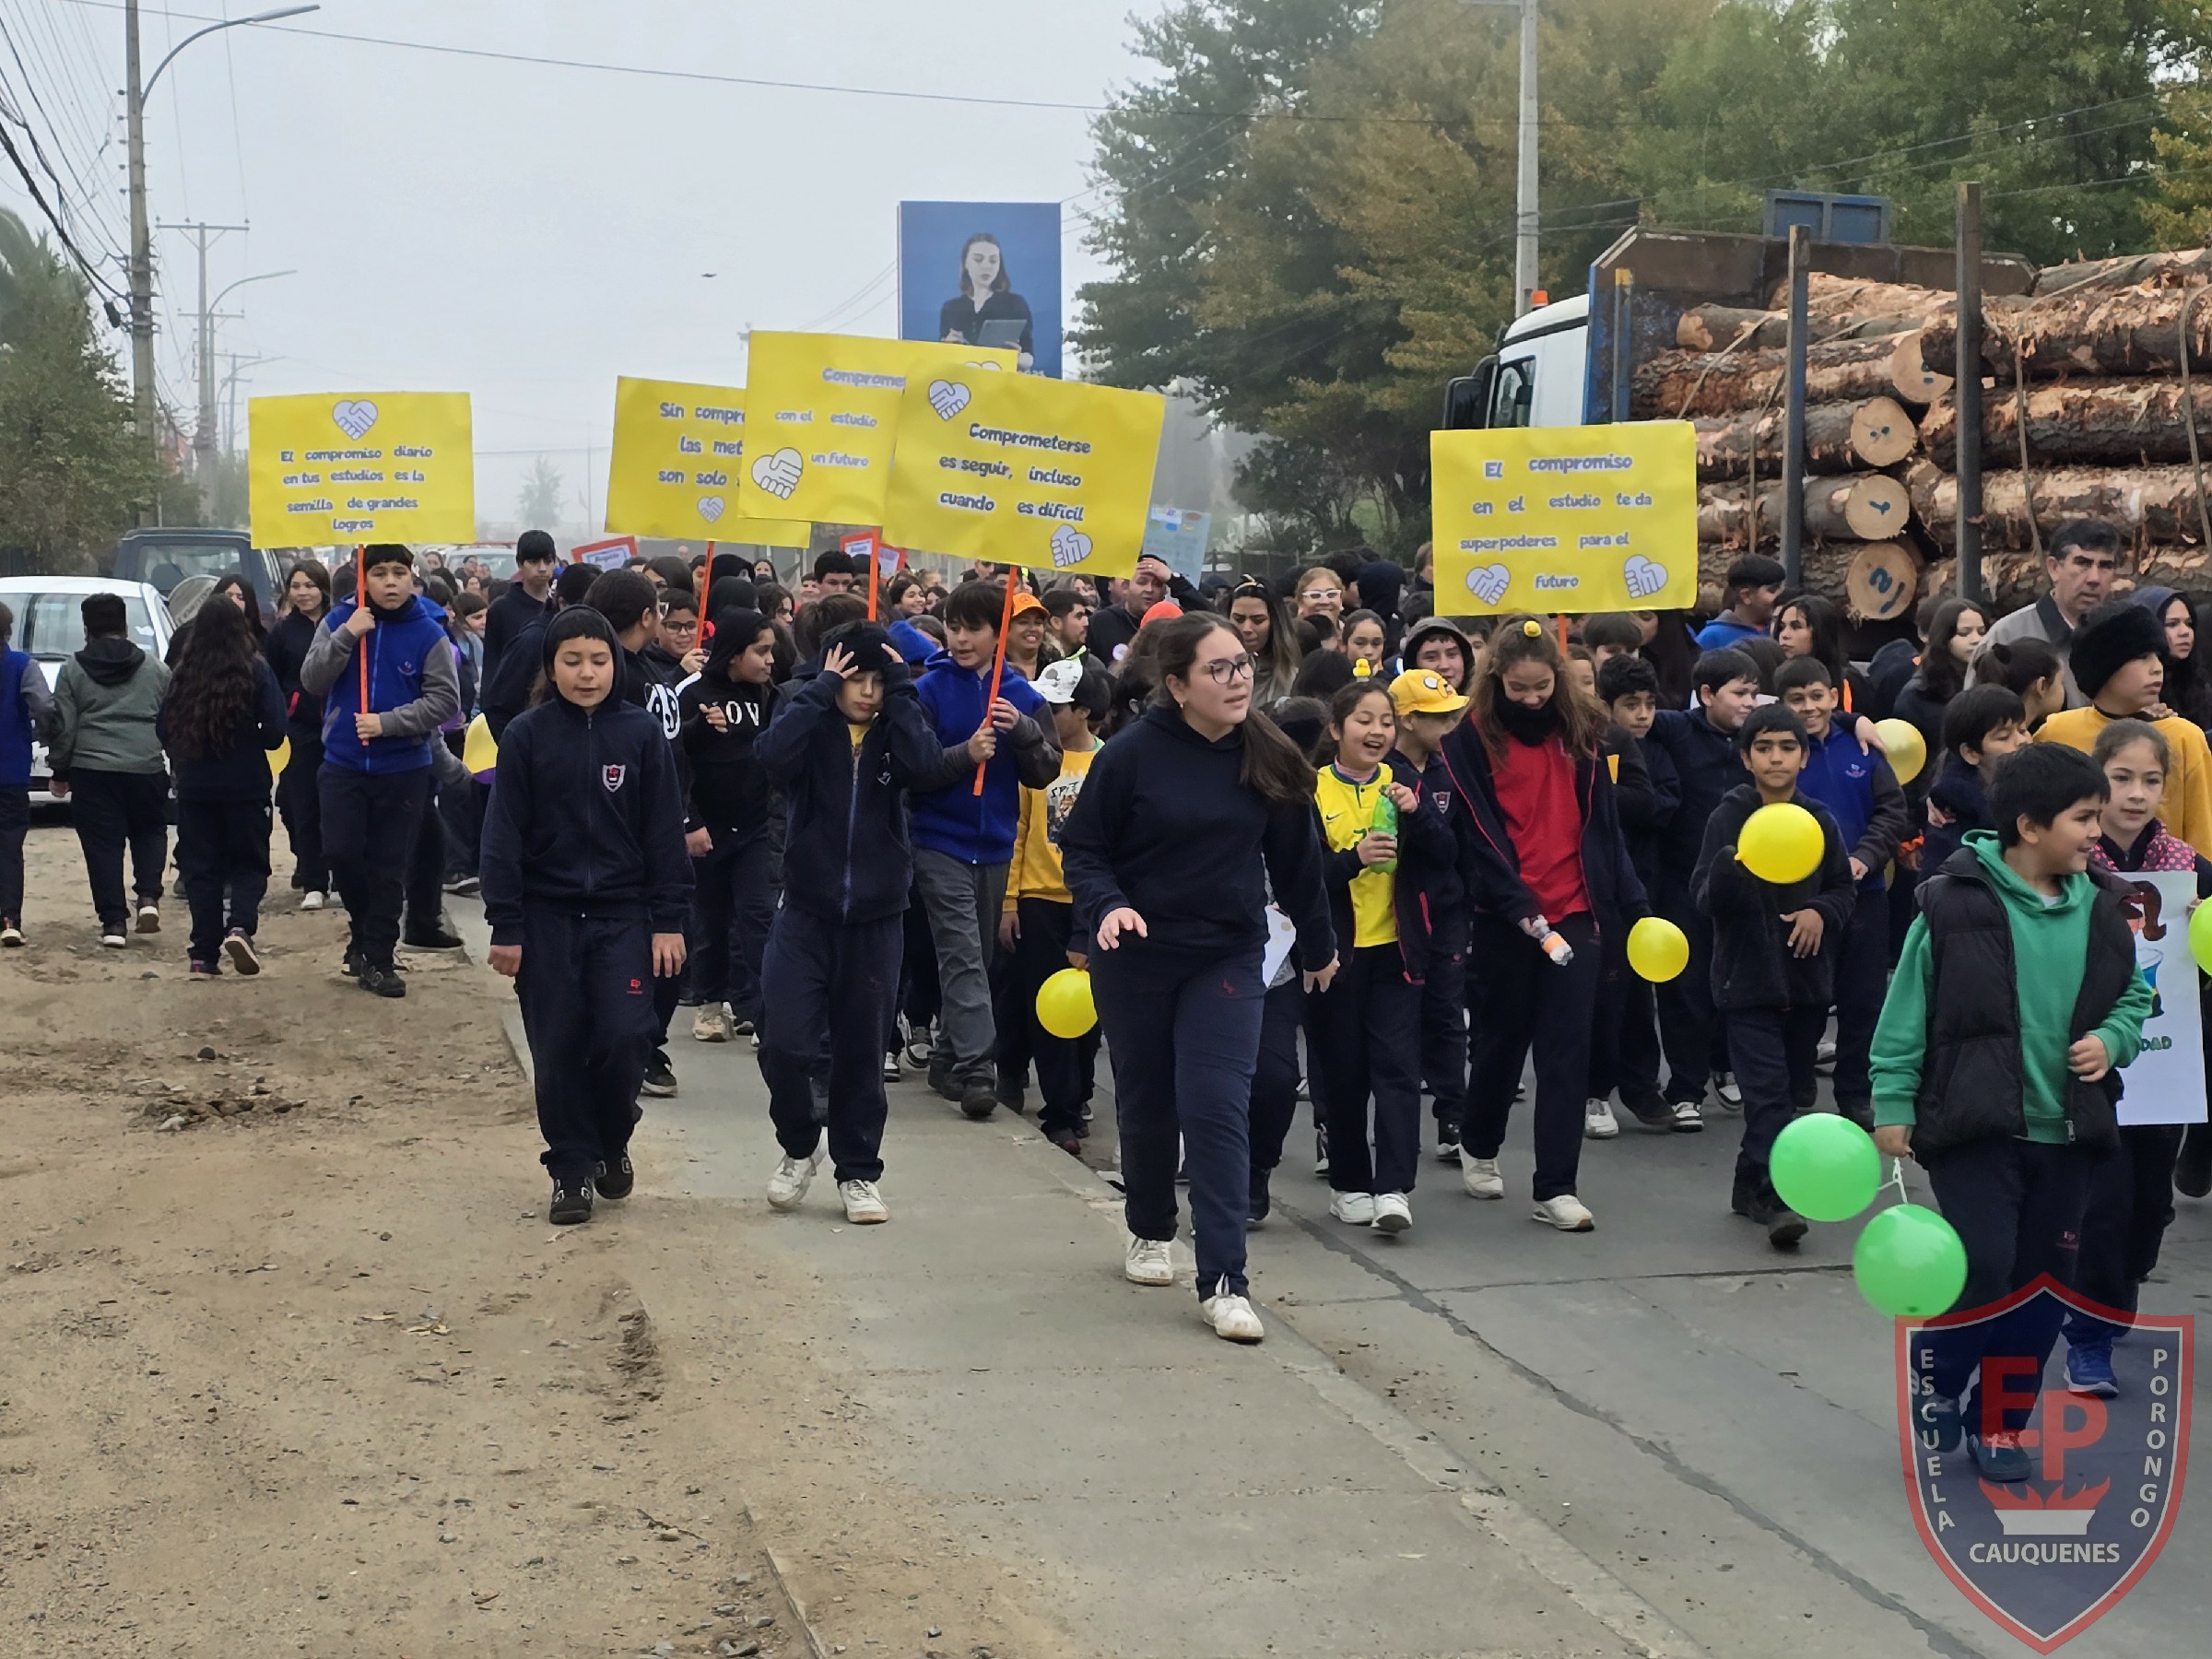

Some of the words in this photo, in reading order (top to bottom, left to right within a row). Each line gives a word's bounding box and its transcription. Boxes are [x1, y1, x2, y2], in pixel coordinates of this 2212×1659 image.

[822, 367, 906, 388] Comprome
[660, 402, 684, 418] Sin
[774, 410, 797, 421] con
[800, 410, 813, 422] el
[830, 413, 877, 428] estudio
[680, 436, 701, 453] las
[969, 422, 1091, 454] Comprometerse
[280, 451, 294, 462] El
[305, 448, 382, 462] compromiso
[394, 445, 433, 458] diario
[811, 453, 826, 464] un
[939, 455, 957, 468] es
[960, 459, 1013, 479] seguir,
[1029, 465, 1081, 487] incluso
[1485, 462, 1502, 477] El
[1528, 453, 1632, 475] compromiso
[283, 476, 298, 485] en
[302, 473, 320, 484] tus
[331, 469, 383, 481] estudios
[394, 471, 408, 481] es
[412, 470, 424, 482] la
[658, 469, 684, 483] son
[696, 469, 726, 486] solo
[287, 499, 334, 512] semilla
[347, 497, 363, 508] de
[367, 497, 418, 511] grandes
[940, 491, 994, 512] cuando
[1017, 501, 1034, 514] es
[1472, 501, 1493, 514] en
[1508, 496, 1525, 512] el
[1548, 494, 1601, 508] estudio
[1616, 493, 1631, 506] te
[1634, 492, 1653, 506] da
[1579, 535, 1611, 549] para
[1615, 532, 1629, 545] el
